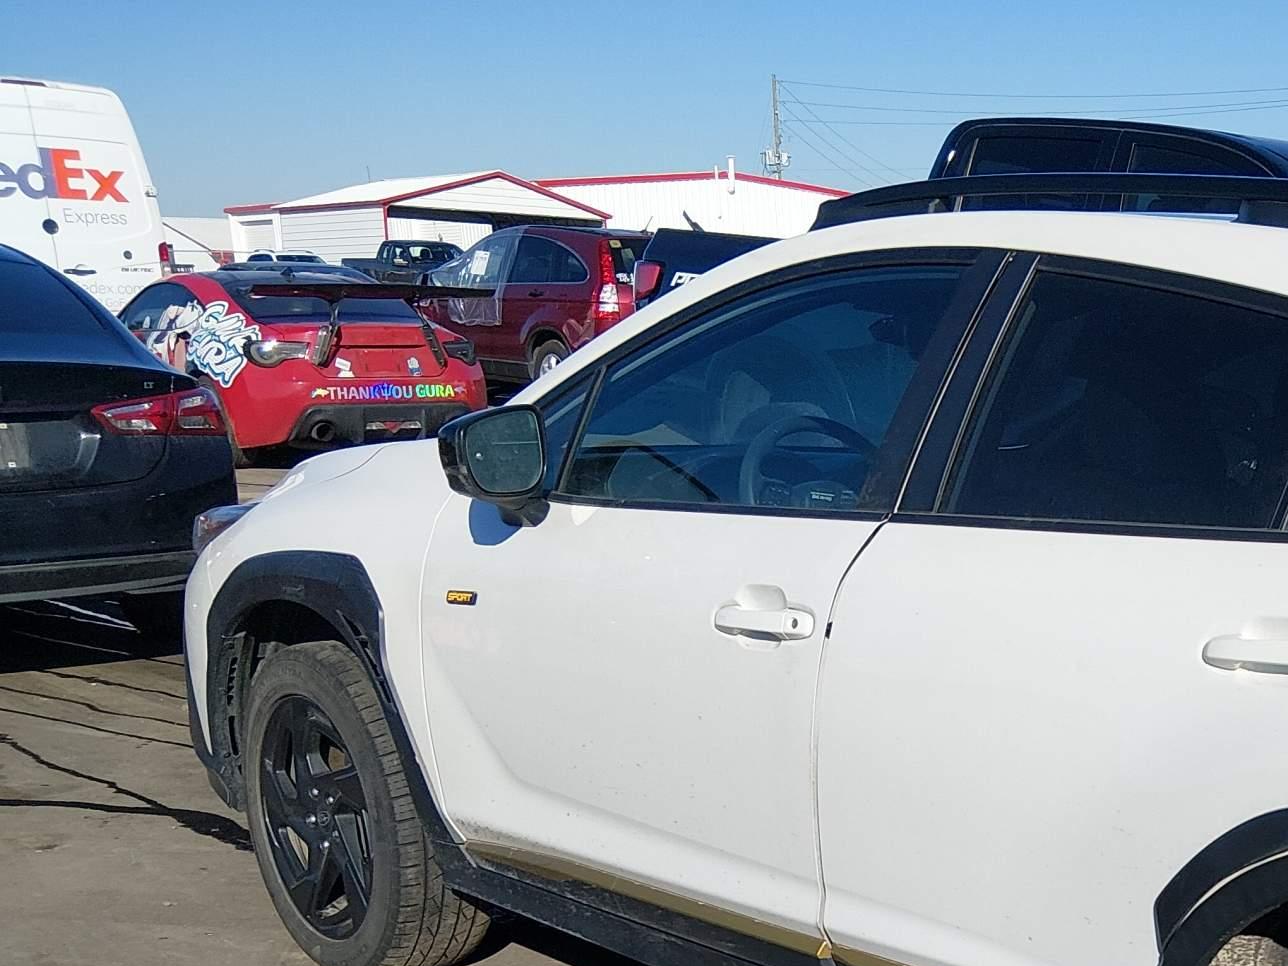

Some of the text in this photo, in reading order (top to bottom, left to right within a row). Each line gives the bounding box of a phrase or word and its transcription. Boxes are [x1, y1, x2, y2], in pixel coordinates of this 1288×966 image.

[63, 208, 128, 226] Express
[415, 384, 456, 398] GURA
[447, 592, 473, 602] SPORT
